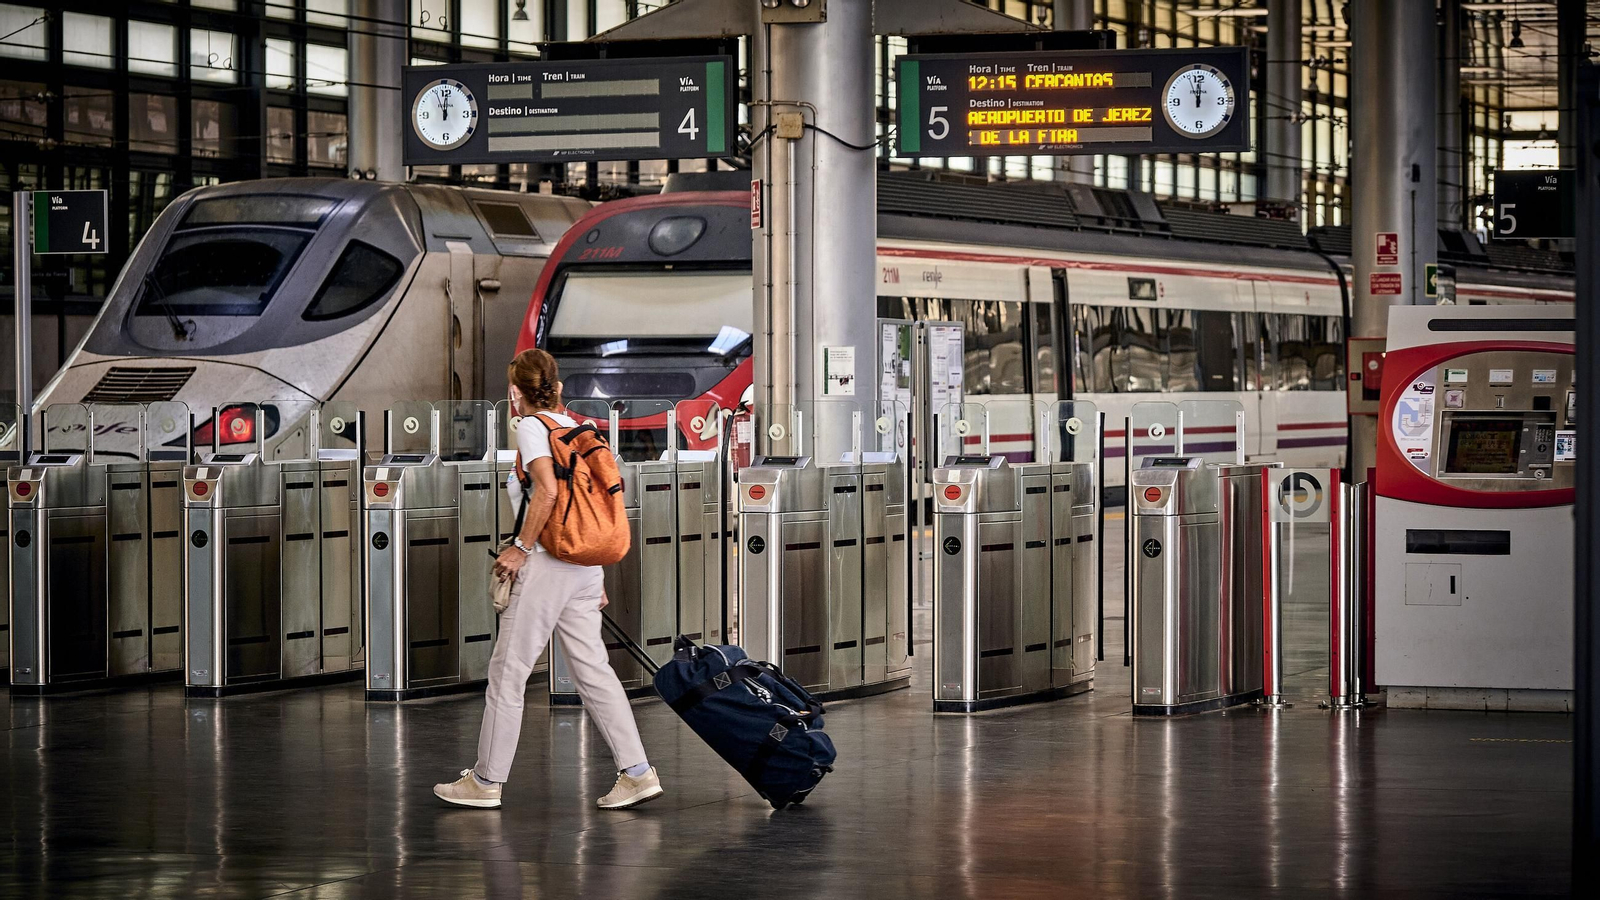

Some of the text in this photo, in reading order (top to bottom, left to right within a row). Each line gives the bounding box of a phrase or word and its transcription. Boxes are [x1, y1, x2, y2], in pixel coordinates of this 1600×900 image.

[969, 65, 992, 73] Hora
[1027, 63, 1049, 72] Tren
[488, 74, 509, 83] Hora
[543, 72, 563, 81] Tren
[1193, 75, 1205, 83] 12
[441, 89, 452, 98] 12
[969, 99, 1005, 108] Destino
[1172, 98, 1181, 106] 9
[1217, 97, 1225, 105] 3
[462, 110, 470, 119] 3
[489, 106, 522, 116] Destino
[968, 107, 1152, 125] AEROPUERTO DE JEREZ
[677, 107, 700, 141] 4
[927, 106, 950, 140] 5
[1195, 120, 1203, 129] 6
[442, 132, 450, 141] 6
[980, 130, 1001, 145] DE
[1009, 129, 1030, 144] LA
[1544, 175, 1558, 184] Vía
[51, 196, 63, 204] Vía
[1499, 203, 1517, 235] 5
[82, 221, 100, 250] 4
[578, 247, 625, 261] 211M
